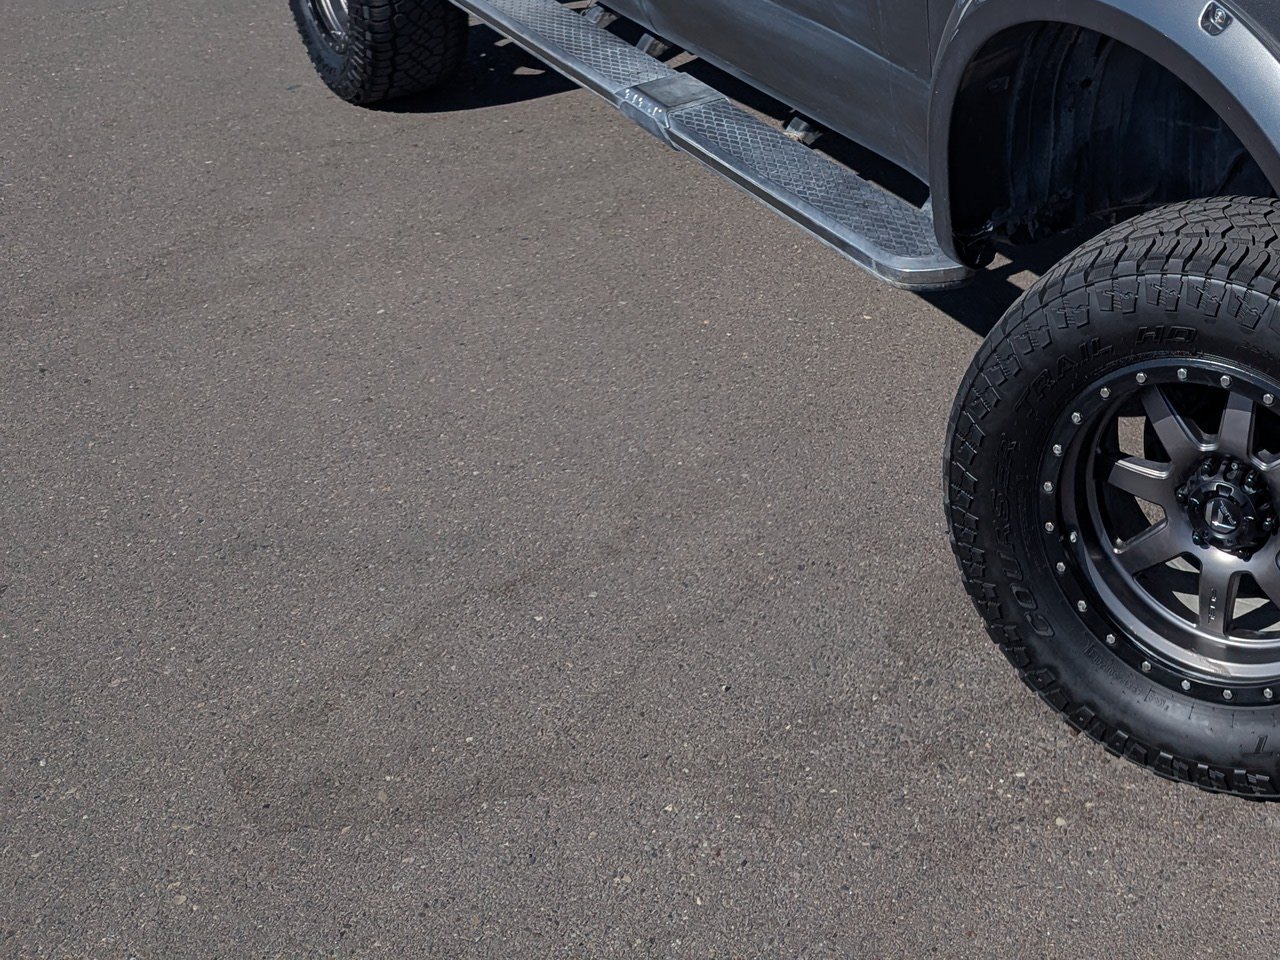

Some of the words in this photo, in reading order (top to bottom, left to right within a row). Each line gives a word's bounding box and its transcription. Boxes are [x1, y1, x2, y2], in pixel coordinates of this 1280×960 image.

[1015, 336, 1114, 413] TRAIL
[1136, 325, 1199, 345] HD
[991, 435, 1055, 638] COURSER
